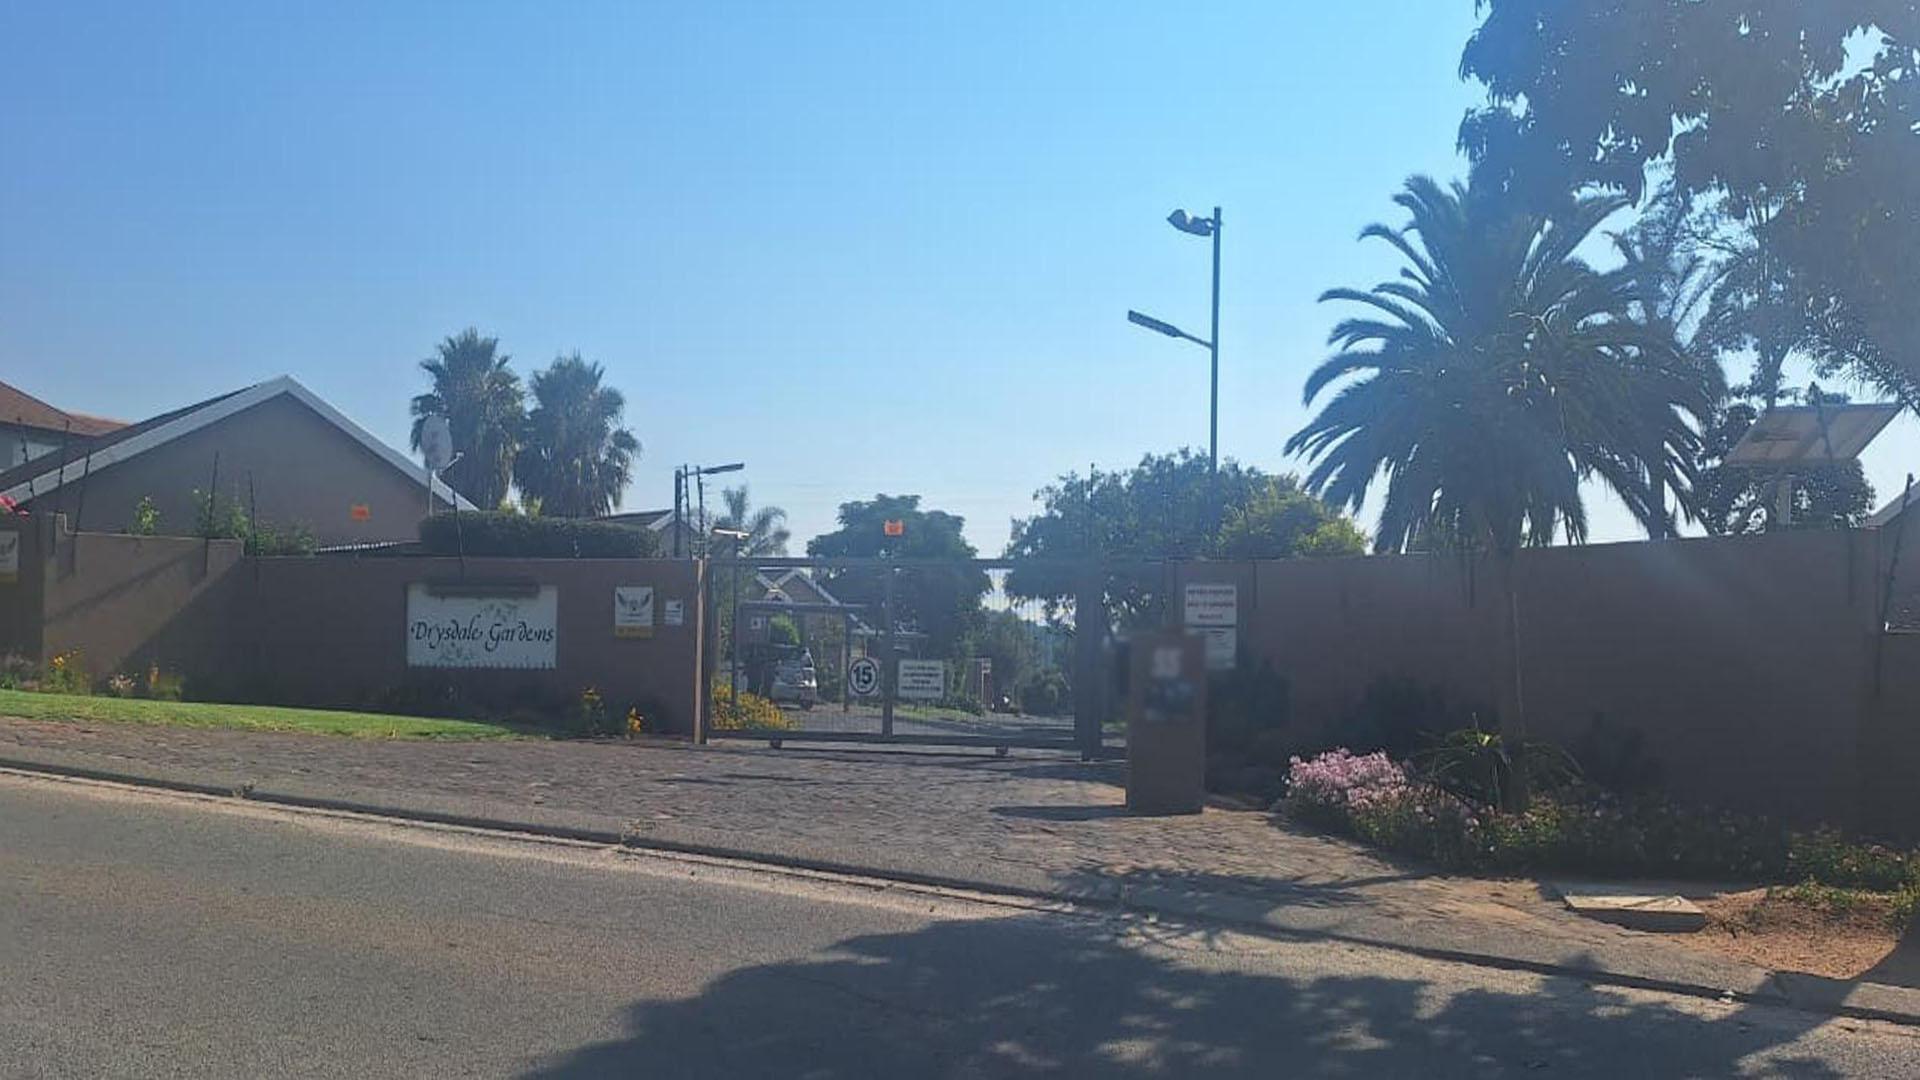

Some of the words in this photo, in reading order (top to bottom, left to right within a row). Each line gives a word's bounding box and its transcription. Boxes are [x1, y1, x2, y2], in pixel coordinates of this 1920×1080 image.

[411, 614, 483, 649] Drysdale
[485, 621, 554, 652] Gardens
[853, 666, 872, 685] 15
